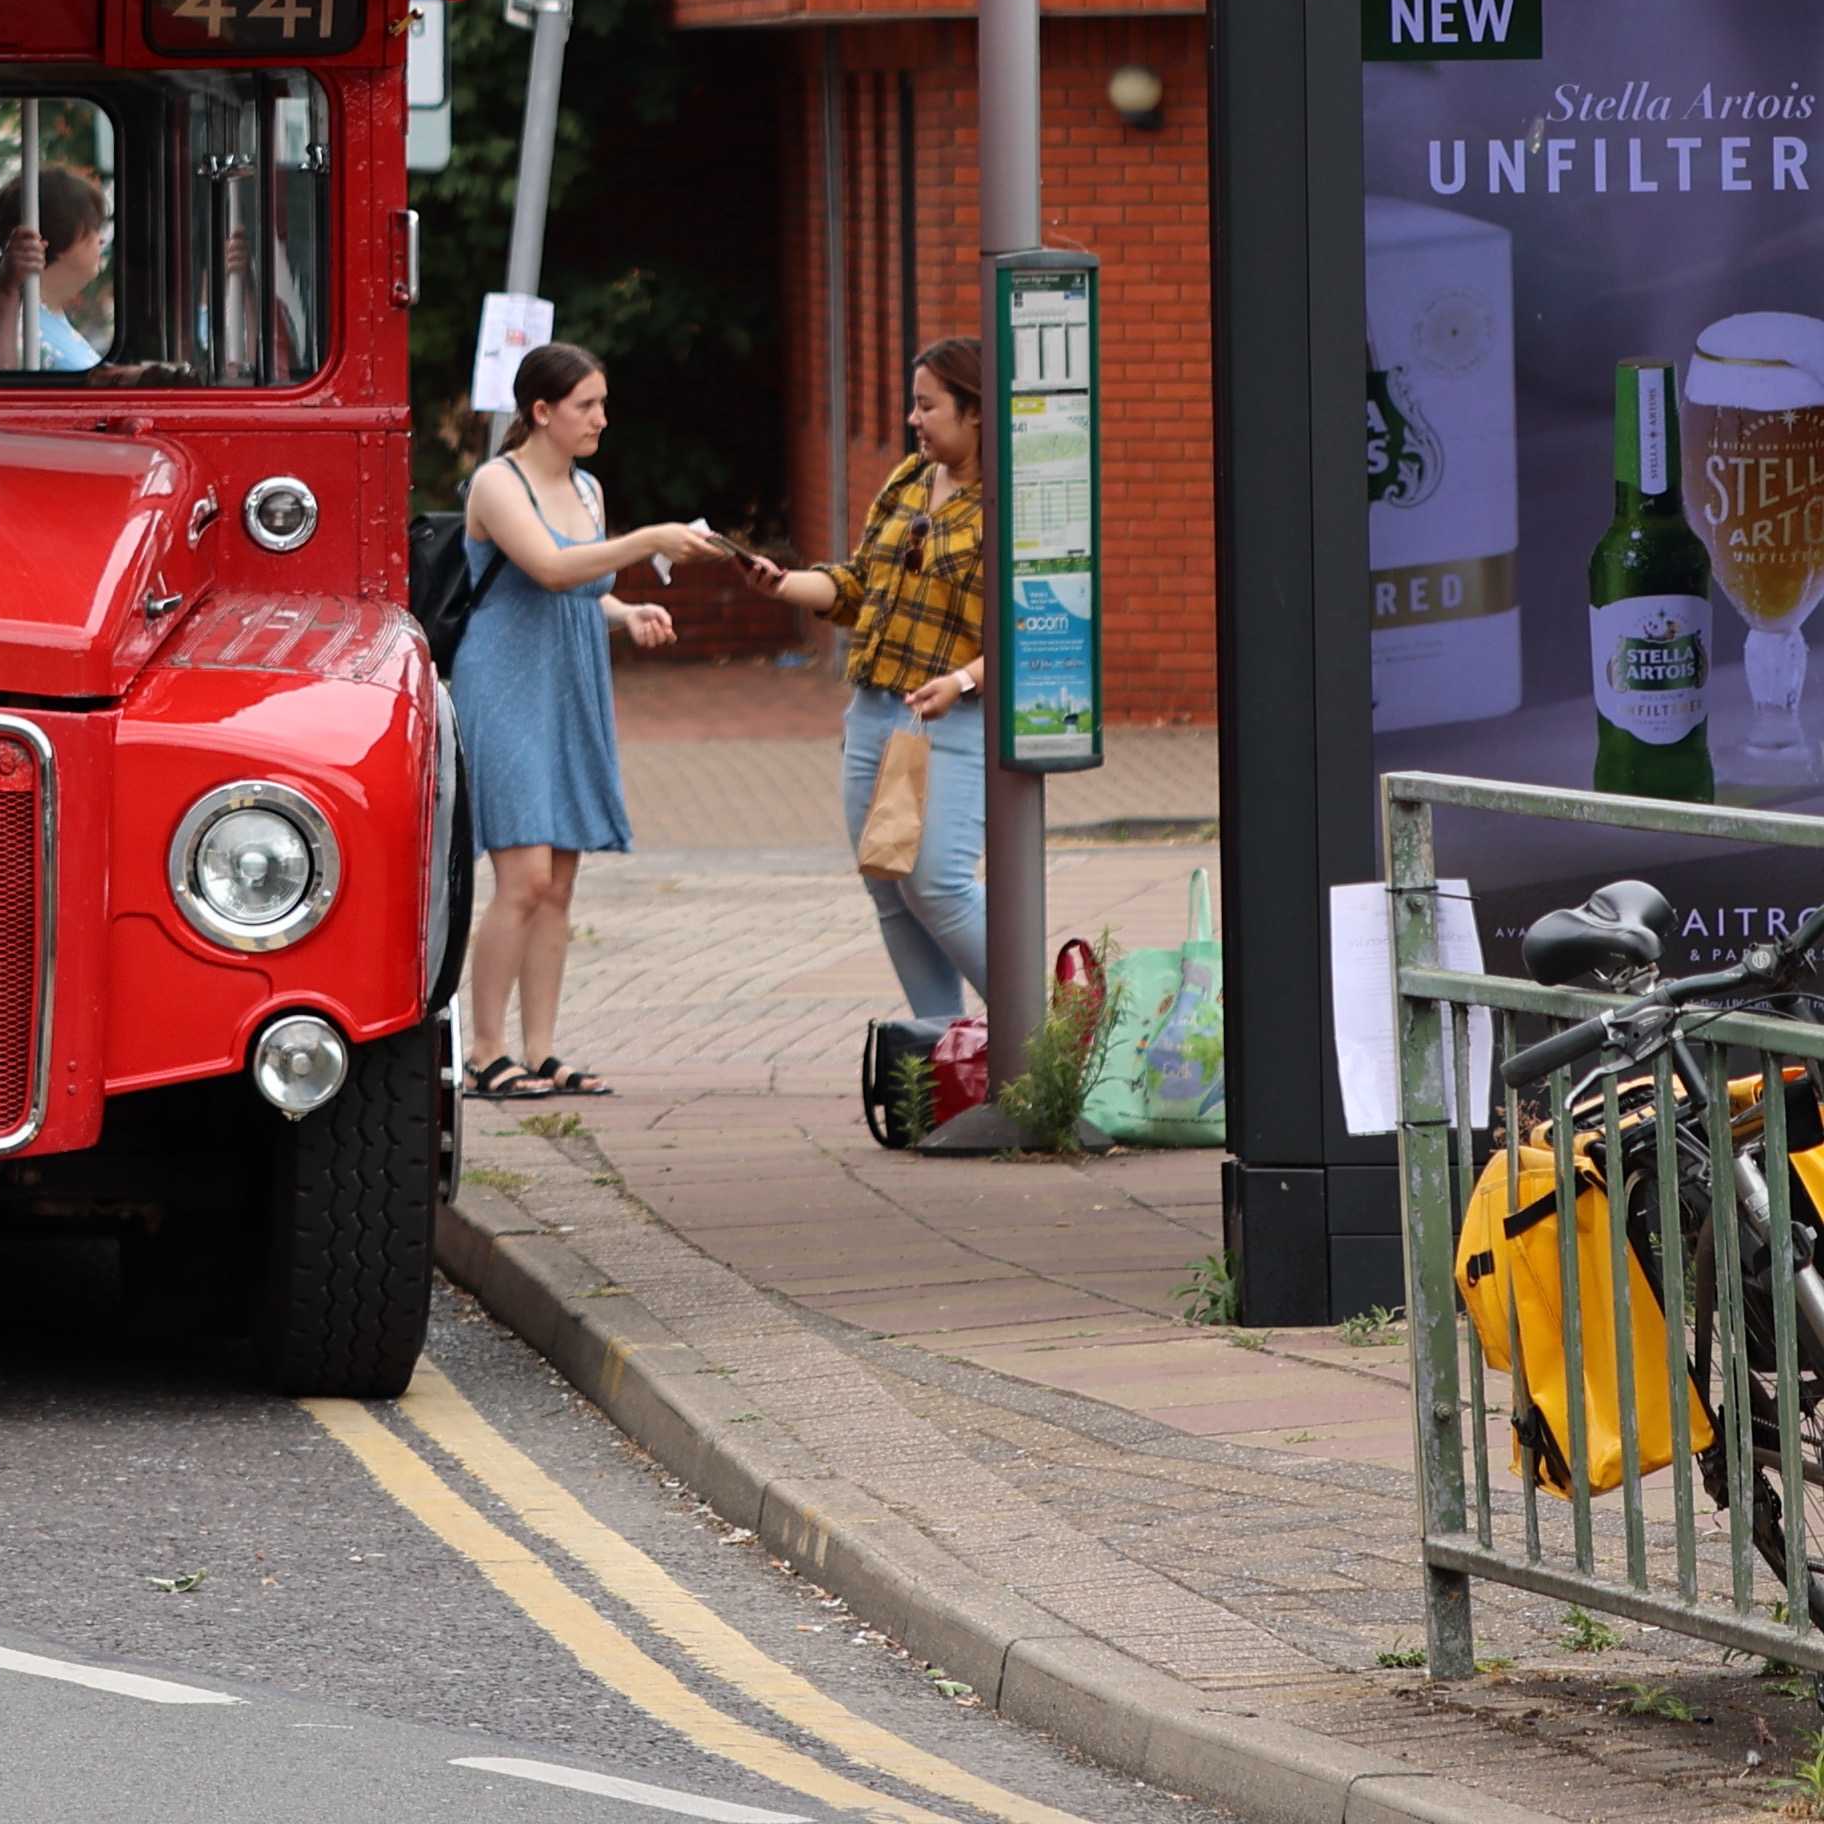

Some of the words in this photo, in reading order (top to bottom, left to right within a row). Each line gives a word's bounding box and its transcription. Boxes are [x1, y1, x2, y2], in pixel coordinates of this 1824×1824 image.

[1546, 80, 1673, 123] Stella
[1681, 81, 1816, 122] Artois
[1428, 136, 1811, 195] UNFILTER
[1625, 646, 1696, 664] STELLA
[1625, 661, 1696, 680] ARTOIS
